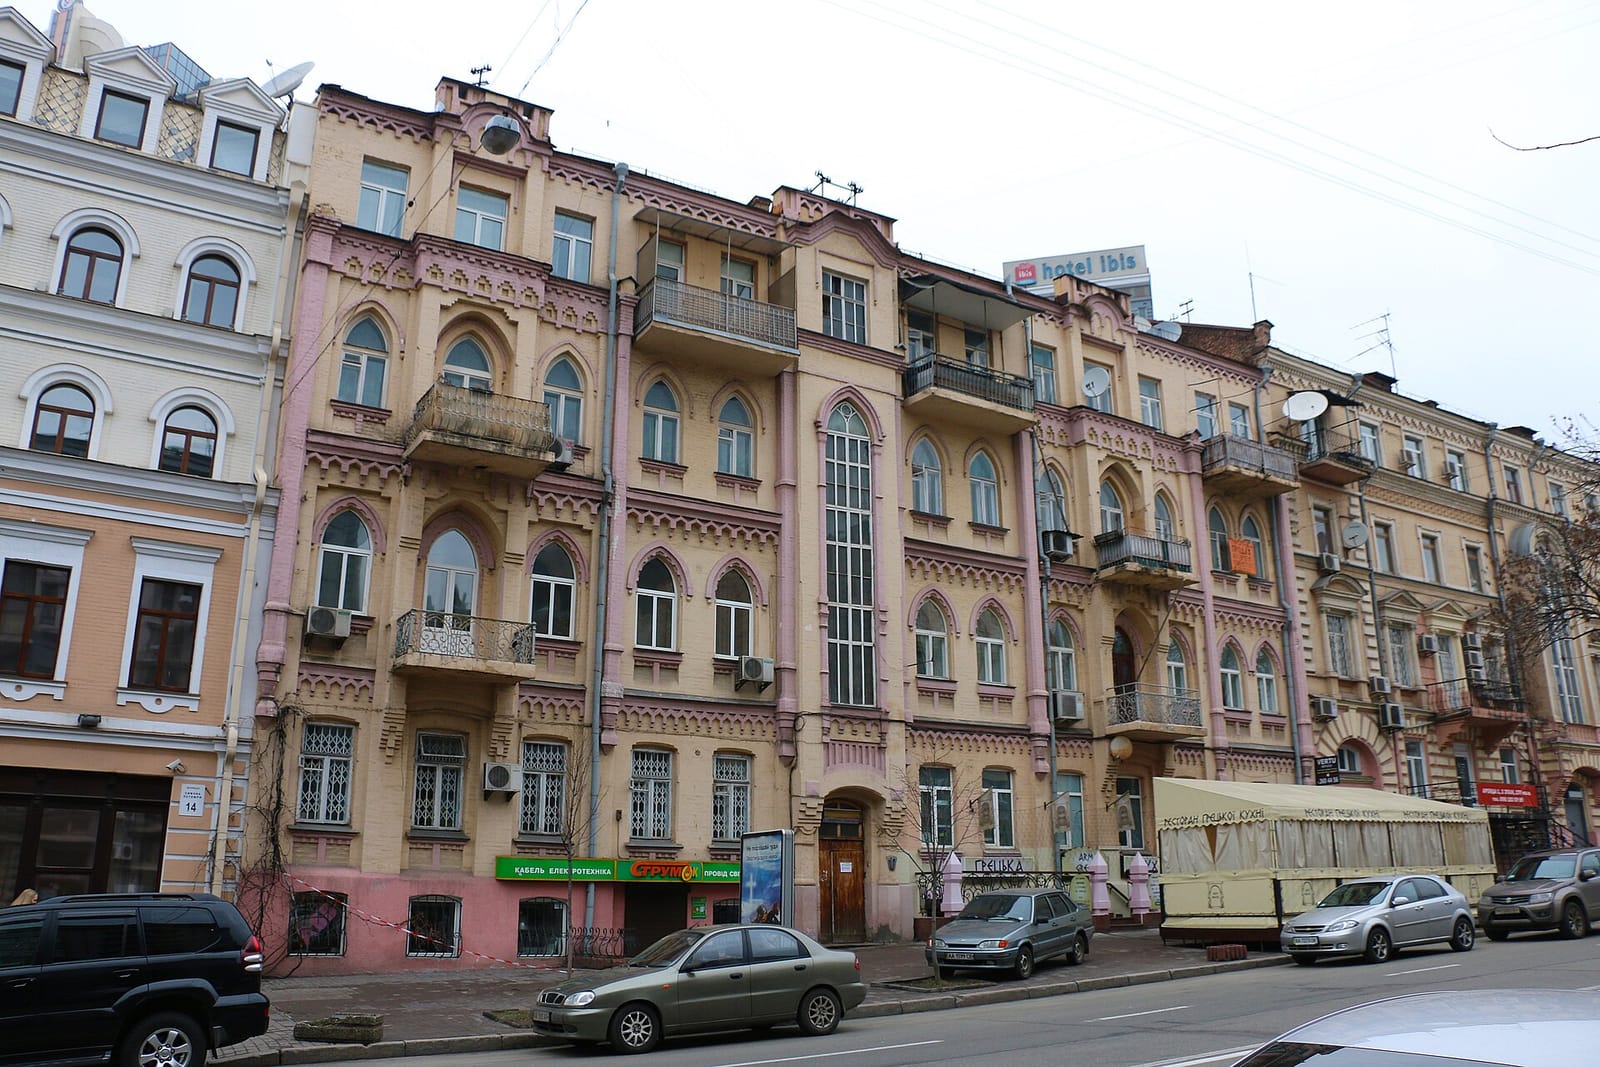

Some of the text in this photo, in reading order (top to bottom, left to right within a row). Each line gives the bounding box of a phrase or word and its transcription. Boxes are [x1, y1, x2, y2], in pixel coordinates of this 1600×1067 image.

[1042, 257, 1092, 280] hotel
[186, 802, 197, 812] 14
[514, 866, 545, 875] КАБЕЛЬ
[975, 859, 1024, 872] ГРЕЦЬКА
